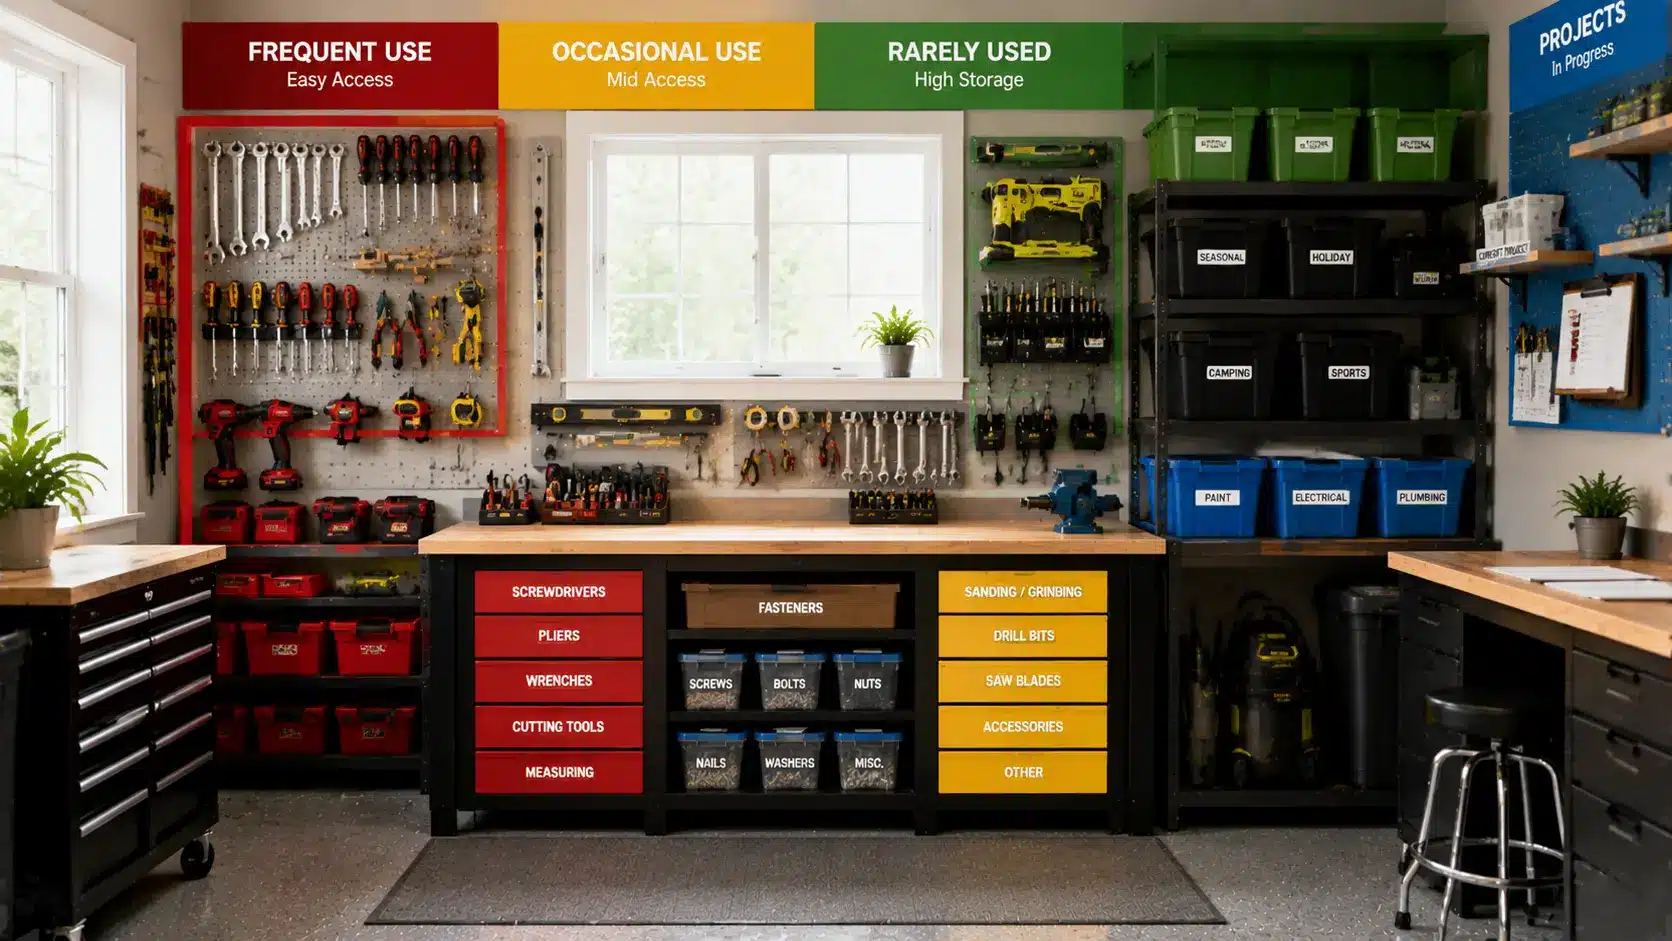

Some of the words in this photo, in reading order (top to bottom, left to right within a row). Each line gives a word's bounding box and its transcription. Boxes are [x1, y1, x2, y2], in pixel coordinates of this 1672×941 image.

[1540, 0, 1626, 55] PROJECTS
[249, 42, 377, 63] FREQUENT
[386, 42, 431, 61] USE
[553, 42, 708, 61] OCCASIONAL
[716, 42, 760, 61] USE
[889, 42, 979, 61] RARELY
[988, 42, 1051, 61] USED
[1551, 60, 1562, 77] In
[1565, 42, 1615, 72] Progress
[288, 72, 327, 90] Easy
[332, 72, 393, 87] Access
[608, 72, 638, 87] Mid
[644, 72, 705, 87] Access
[916, 72, 953, 91] High
[960, 72, 1023, 90] Storage
[1199, 252, 1245, 262] SEASONAL
[1312, 252, 1351, 262] HOLIDAY
[1208, 368, 1251, 378] CAMPING
[1331, 368, 1367, 378] SPORTS
[1204, 493, 1232, 503] PAINT
[1295, 492, 1348, 503] ELECTRICAL
[1399, 492, 1446, 502] PLUMBING
[512, 585, 606, 598] SCREWDRIVERS
[964, 585, 1017, 598] SANDING
[758, 601, 824, 614] FASTENERS
[538, 629, 580, 642] PLIERS
[993, 629, 1027, 642] DRILL
[1029, 629, 1055, 642] BITS
[525, 674, 593, 687] WRENCHES
[689, 678, 733, 690] SCREWS
[773, 678, 806, 689] BOLTS
[854, 678, 882, 689] NUTS
[986, 674, 1013, 687] SAW
[1016, 674, 1062, 687] BLADES
[512, 720, 564, 733] CUTTING
[565, 720, 605, 733] TOOLS
[983, 720, 1064, 733] ACCESSORIES
[696, 757, 727, 769] NAILS
[765, 757, 815, 769] WASHERS
[854, 757, 884, 769] MISC.
[525, 766, 595, 779] MEASURING
[1004, 766, 1043, 779] OTHER
